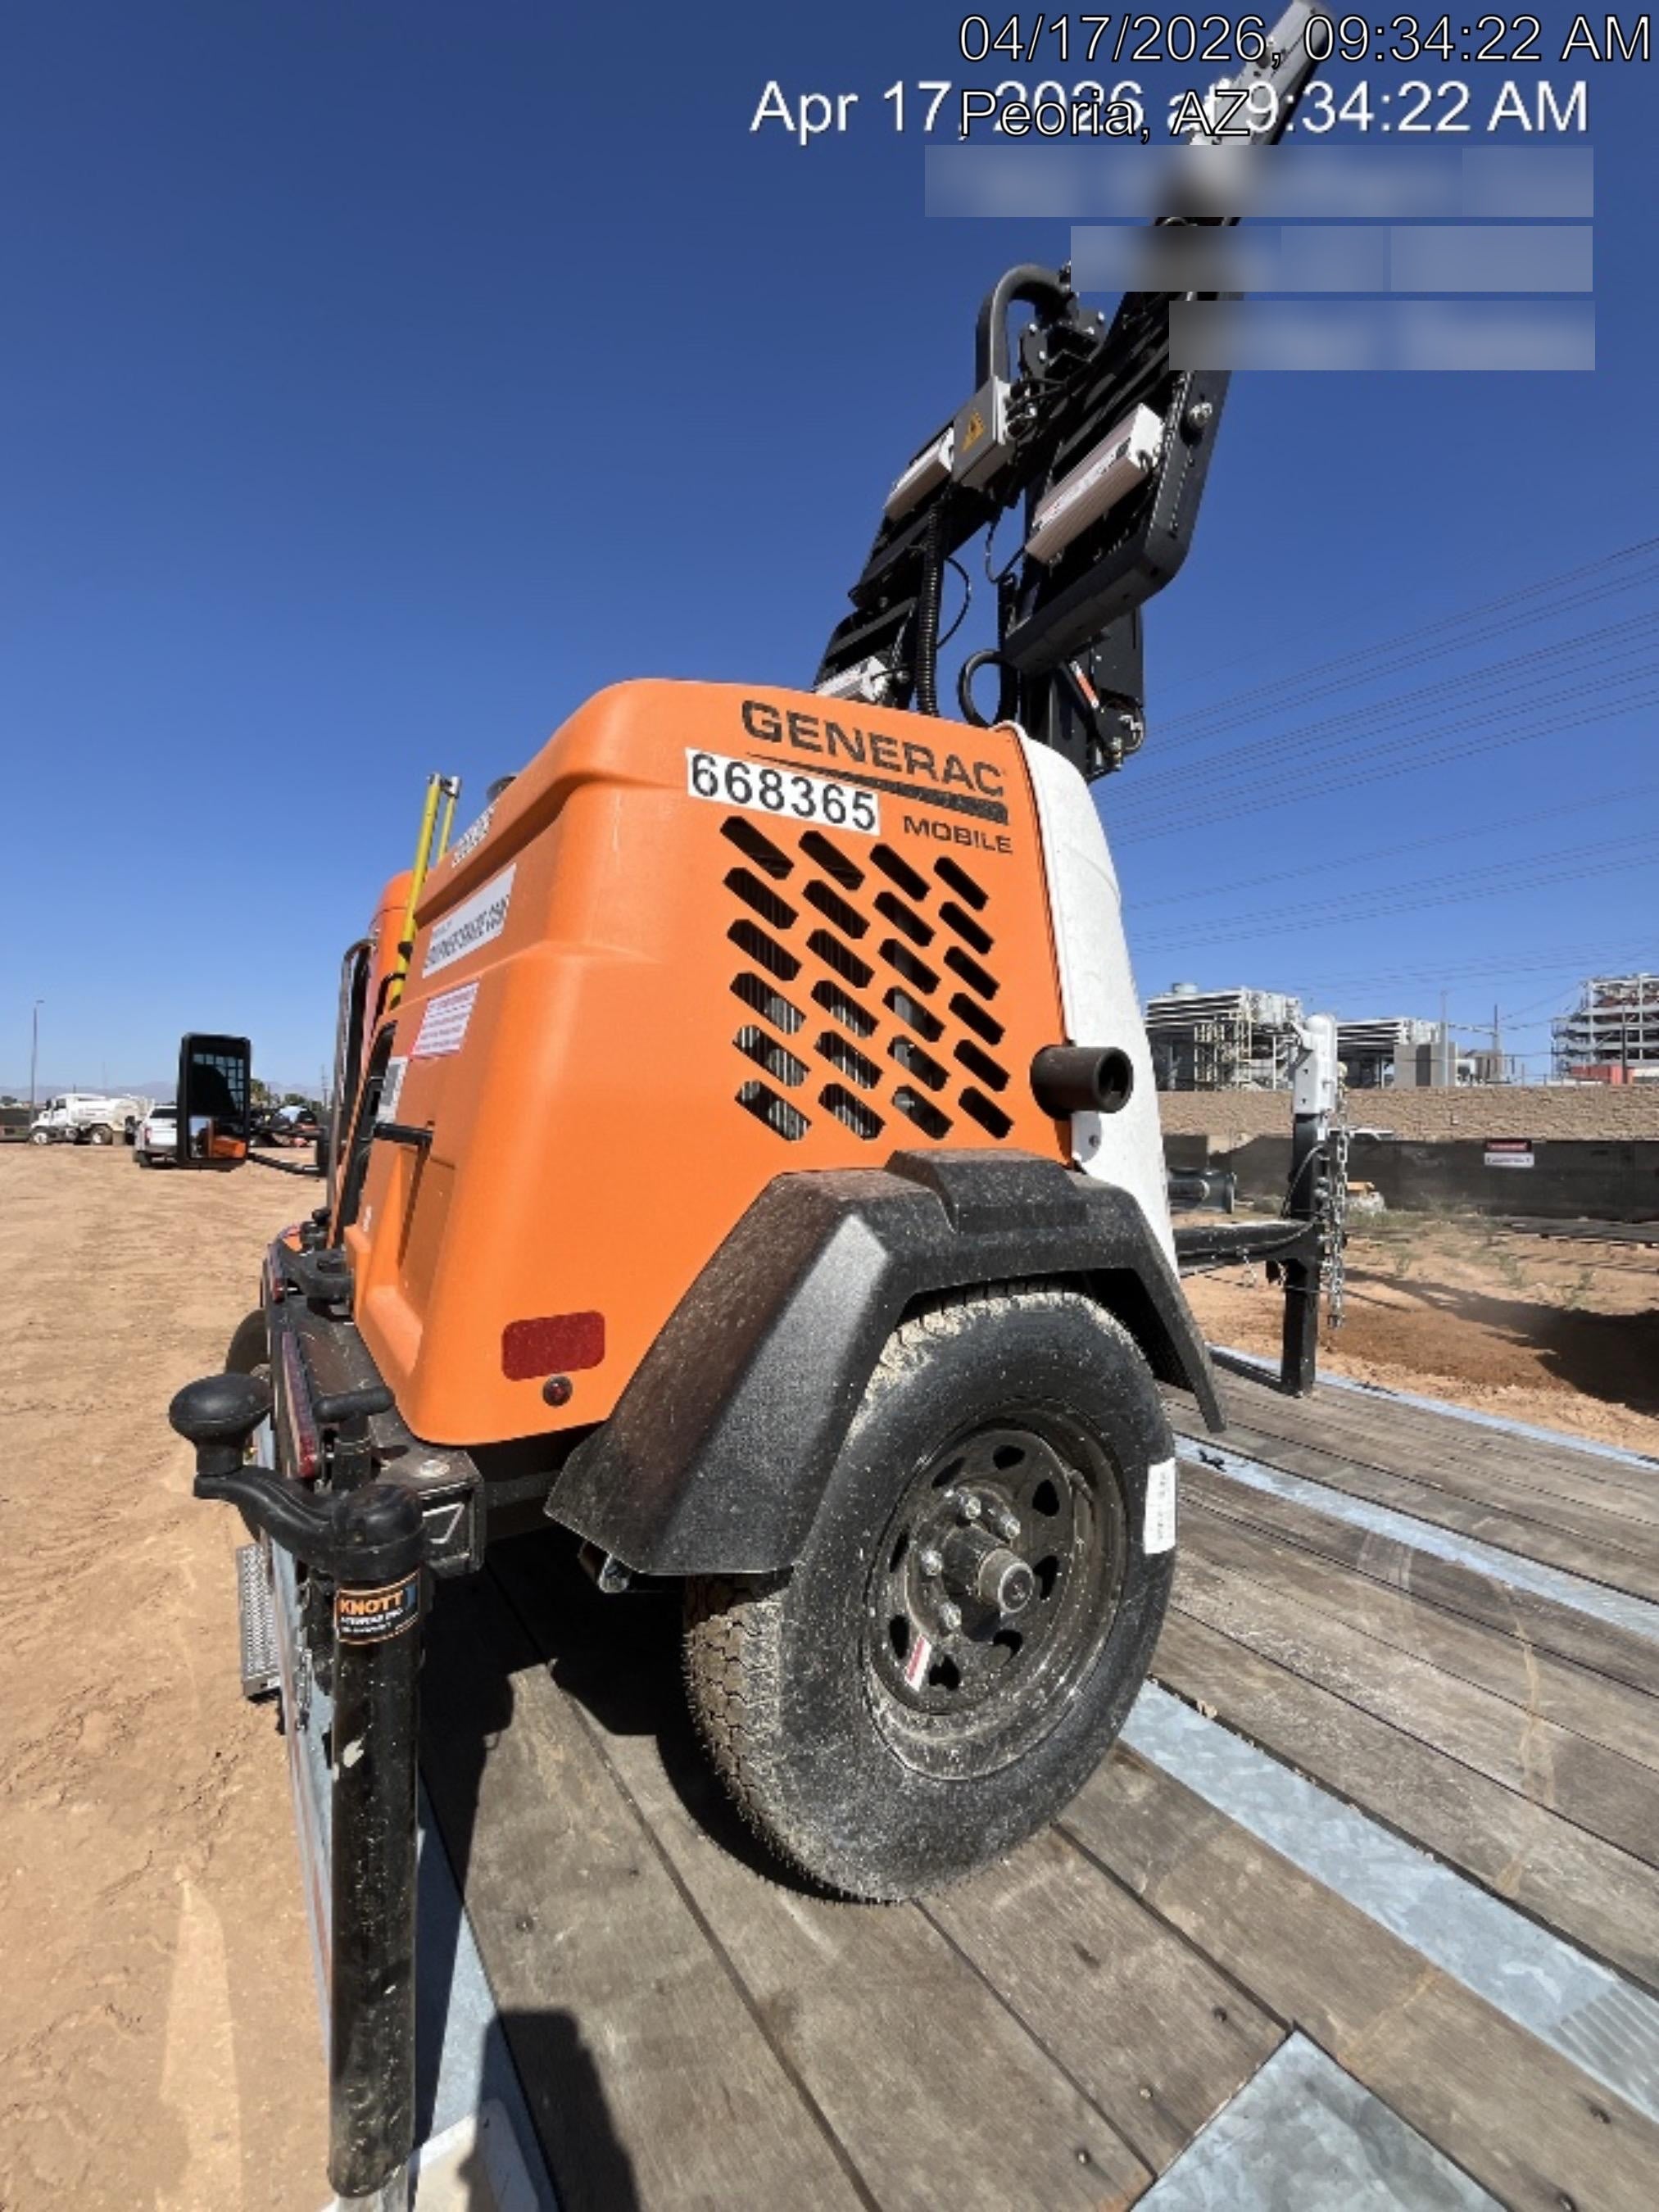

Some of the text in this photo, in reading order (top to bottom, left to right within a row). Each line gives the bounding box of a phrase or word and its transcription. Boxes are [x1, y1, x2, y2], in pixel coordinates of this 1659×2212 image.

[741, 699, 1006, 797] GENERAC
[691, 752, 877, 832] 668365
[903, 814, 1013, 854] MOBILE
[340, 1590, 404, 1616] KNOTT
